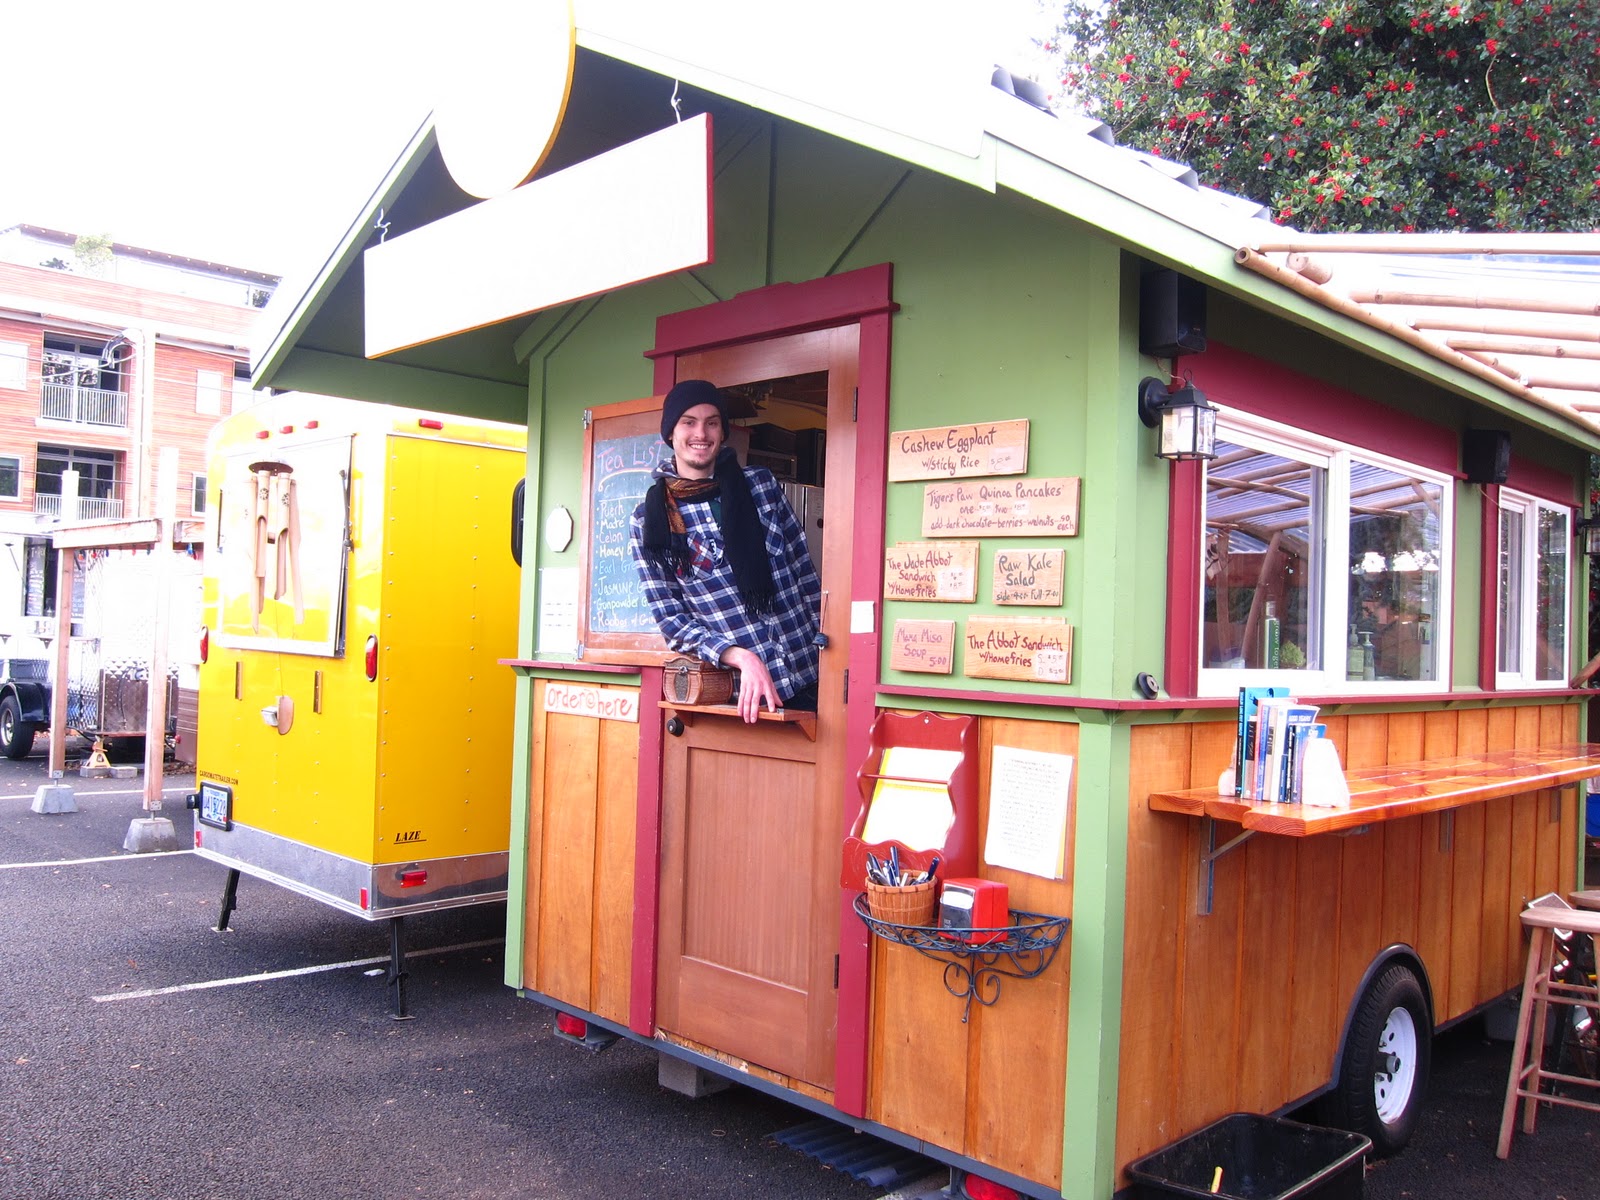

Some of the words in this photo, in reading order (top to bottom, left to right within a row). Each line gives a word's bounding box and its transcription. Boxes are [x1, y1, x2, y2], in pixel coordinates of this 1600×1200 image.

[901, 435, 944, 453] Cashew
[947, 427, 997, 453] Eggplant
[597, 446, 624, 474] Tea
[960, 455, 980, 468] Rice
[957, 487, 973, 502] Paw
[980, 485, 1012, 500] Quinoa
[1016, 482, 1062, 498] Pancakes
[995, 504, 1008, 514] two
[1057, 520, 1075, 531] each
[600, 544, 624, 561] Honey
[887, 558, 902, 570] The
[904, 553, 925, 570] Jade
[926, 551, 953, 569] Abbot
[599, 559, 616, 575] Earl
[999, 555, 1021, 574] Raw
[1028, 552, 1052, 571] Kale
[899, 569, 936, 583] Sandwich
[1006, 570, 1035, 586] Salad
[996, 590, 1010, 601] side
[597, 594, 639, 616] Gunpowder
[921, 629, 943, 643] Miso
[967, 635, 985, 649] The
[987, 630, 1021, 650] Abbot
[1021, 635, 1063, 651] Sandwich
[904, 643, 927, 660] Soup
[395, 830, 421, 842] LAZE
